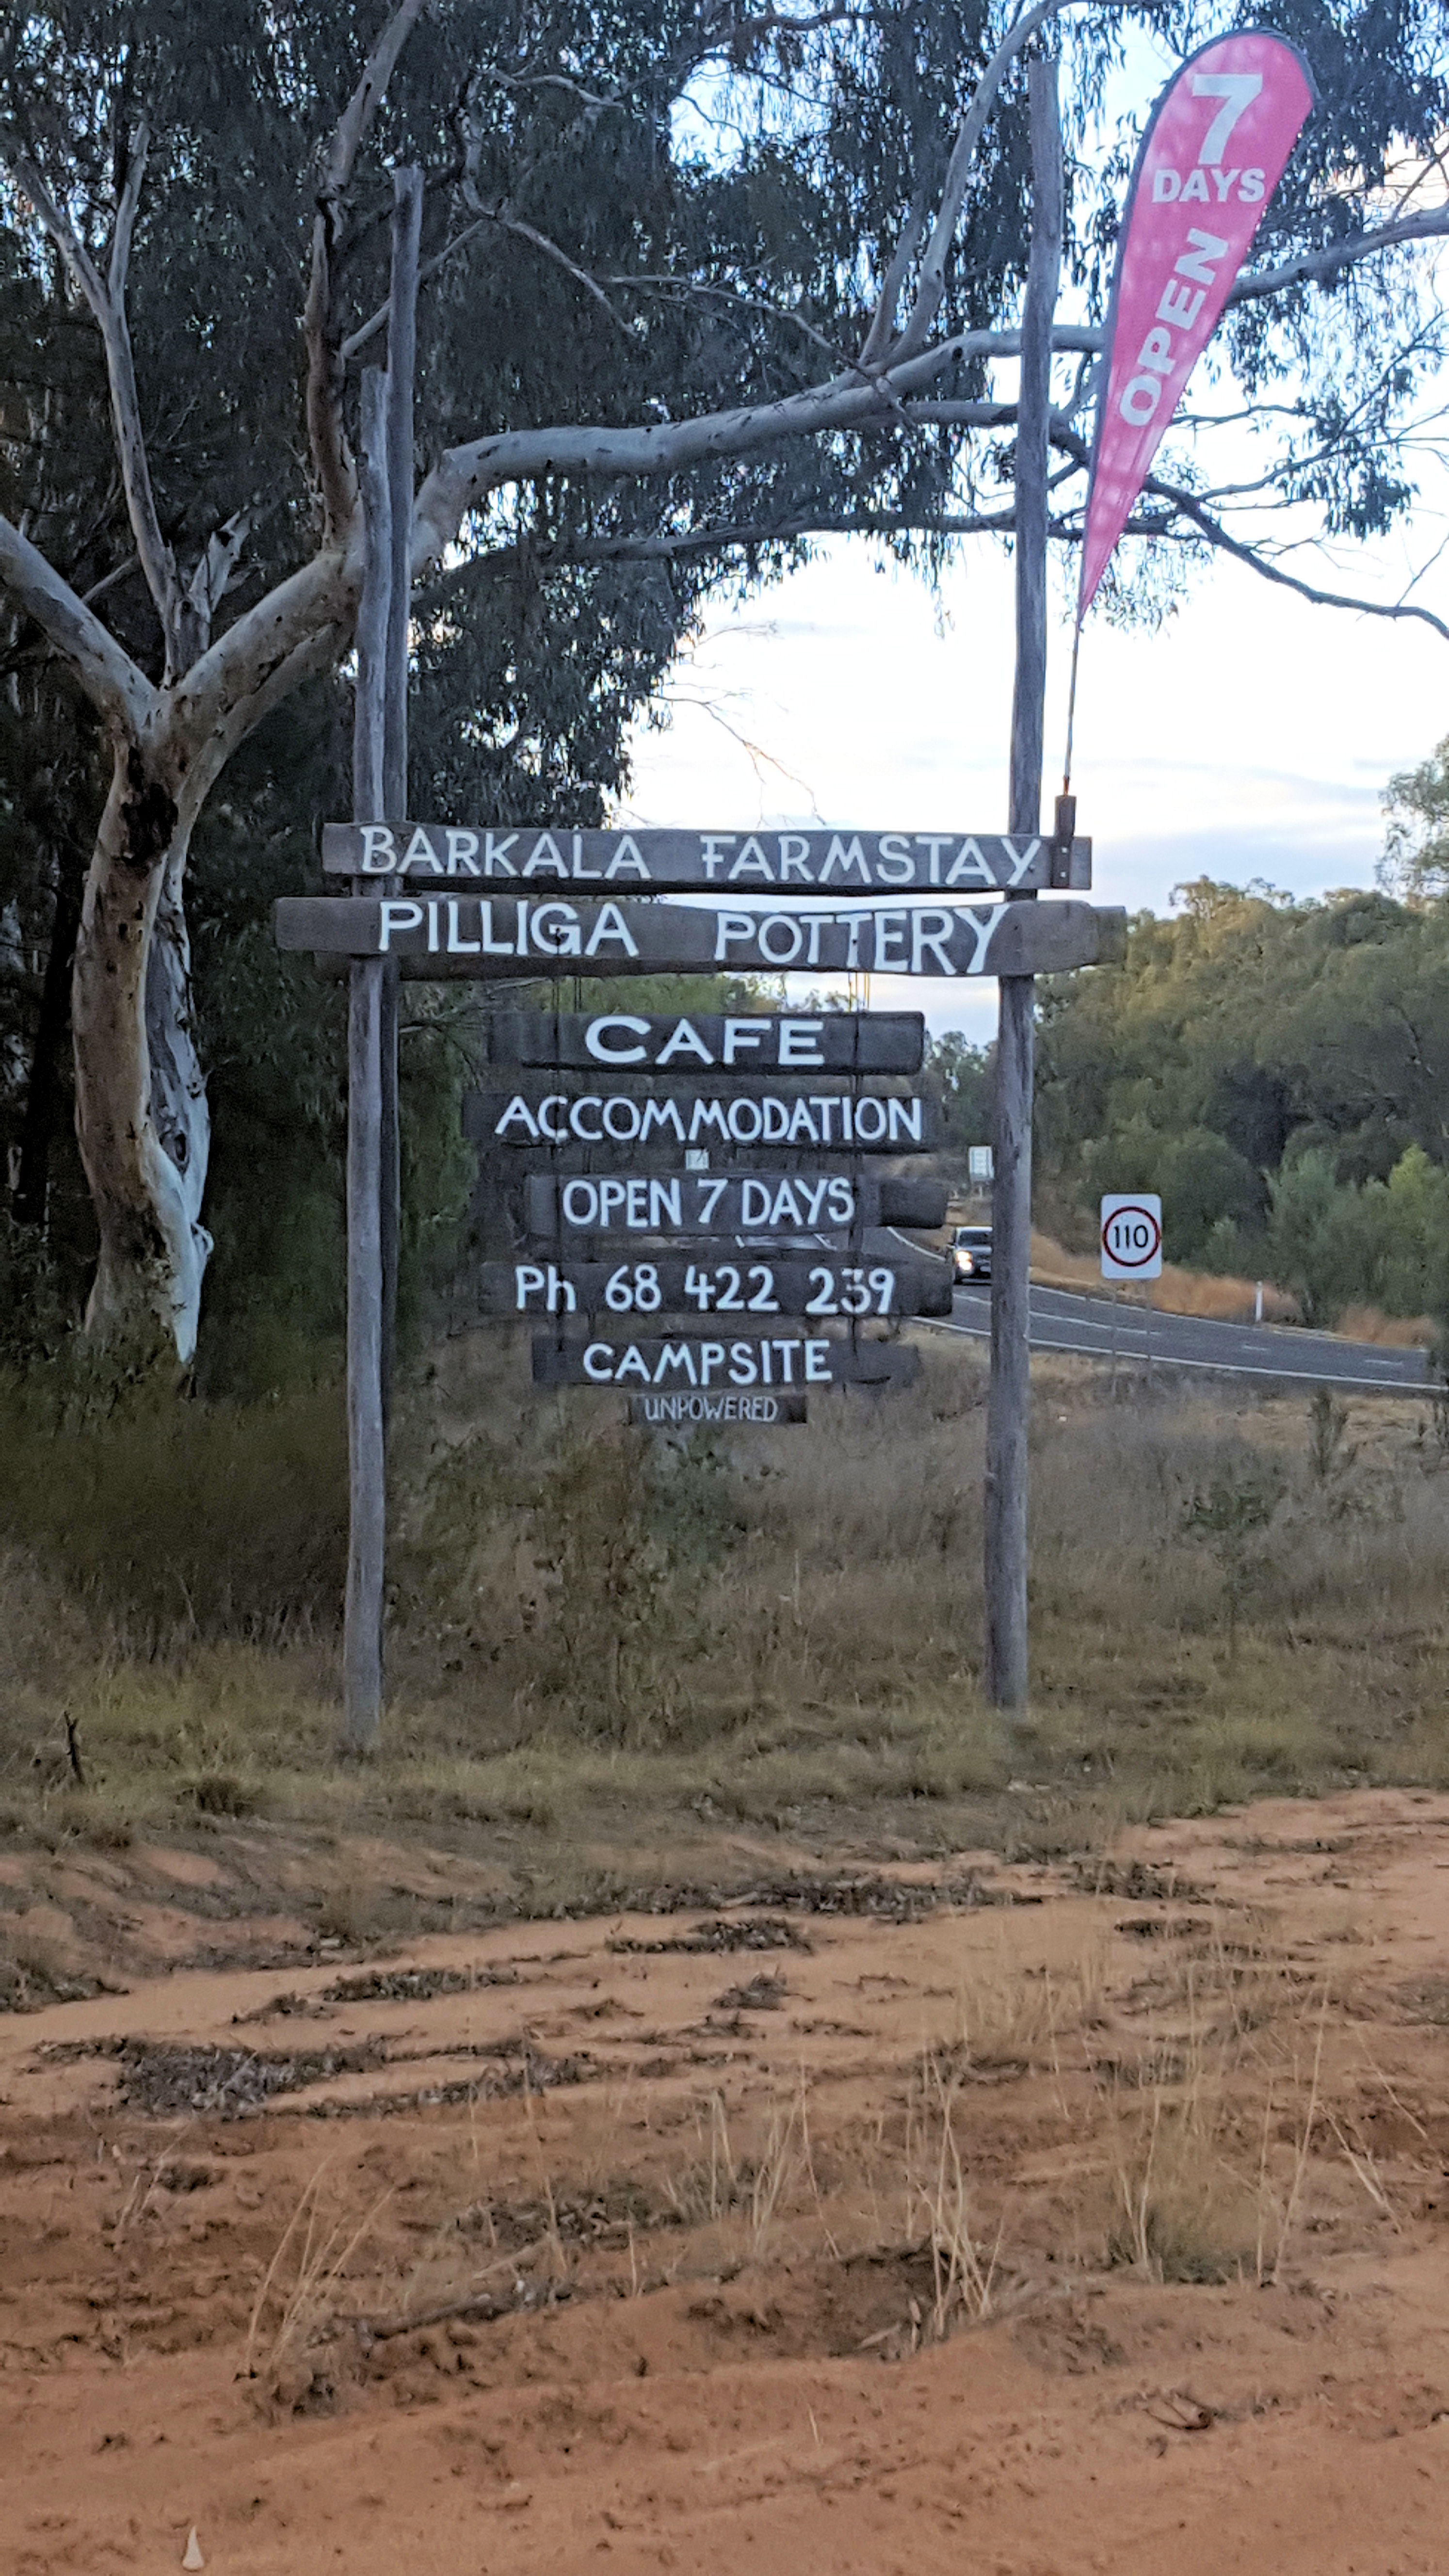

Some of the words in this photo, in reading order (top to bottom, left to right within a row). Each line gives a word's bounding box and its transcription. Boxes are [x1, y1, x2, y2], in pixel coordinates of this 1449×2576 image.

[1192, 73, 1263, 165] 7
[1152, 168, 1265, 203] DAYS
[1119, 227, 1229, 427] OPEN
[359, 825, 652, 879] BARKALA
[700, 835, 1042, 886] FARMSTAY
[378, 900, 639, 957] PILLIGA
[714, 903, 1011, 975] POTTERY
[585, 1015, 825, 1065] CAFE
[495, 1095, 922, 1142] ACCOMMODATION
[562, 1178, 682, 1227] OPEN
[697, 1179, 728, 1224] 7
[742, 1177, 855, 1226] DAYS
[1114, 1225, 1148, 1249] 110
[515, 1265, 577, 1312] Ph
[605, 1265, 661, 1311] 68
[684, 1266, 779, 1312] 422
[805, 1268, 895, 1315] 239
[583, 1340, 833, 1386] CAMPSITE
[644, 1396, 777, 1422] UNPOWERED
